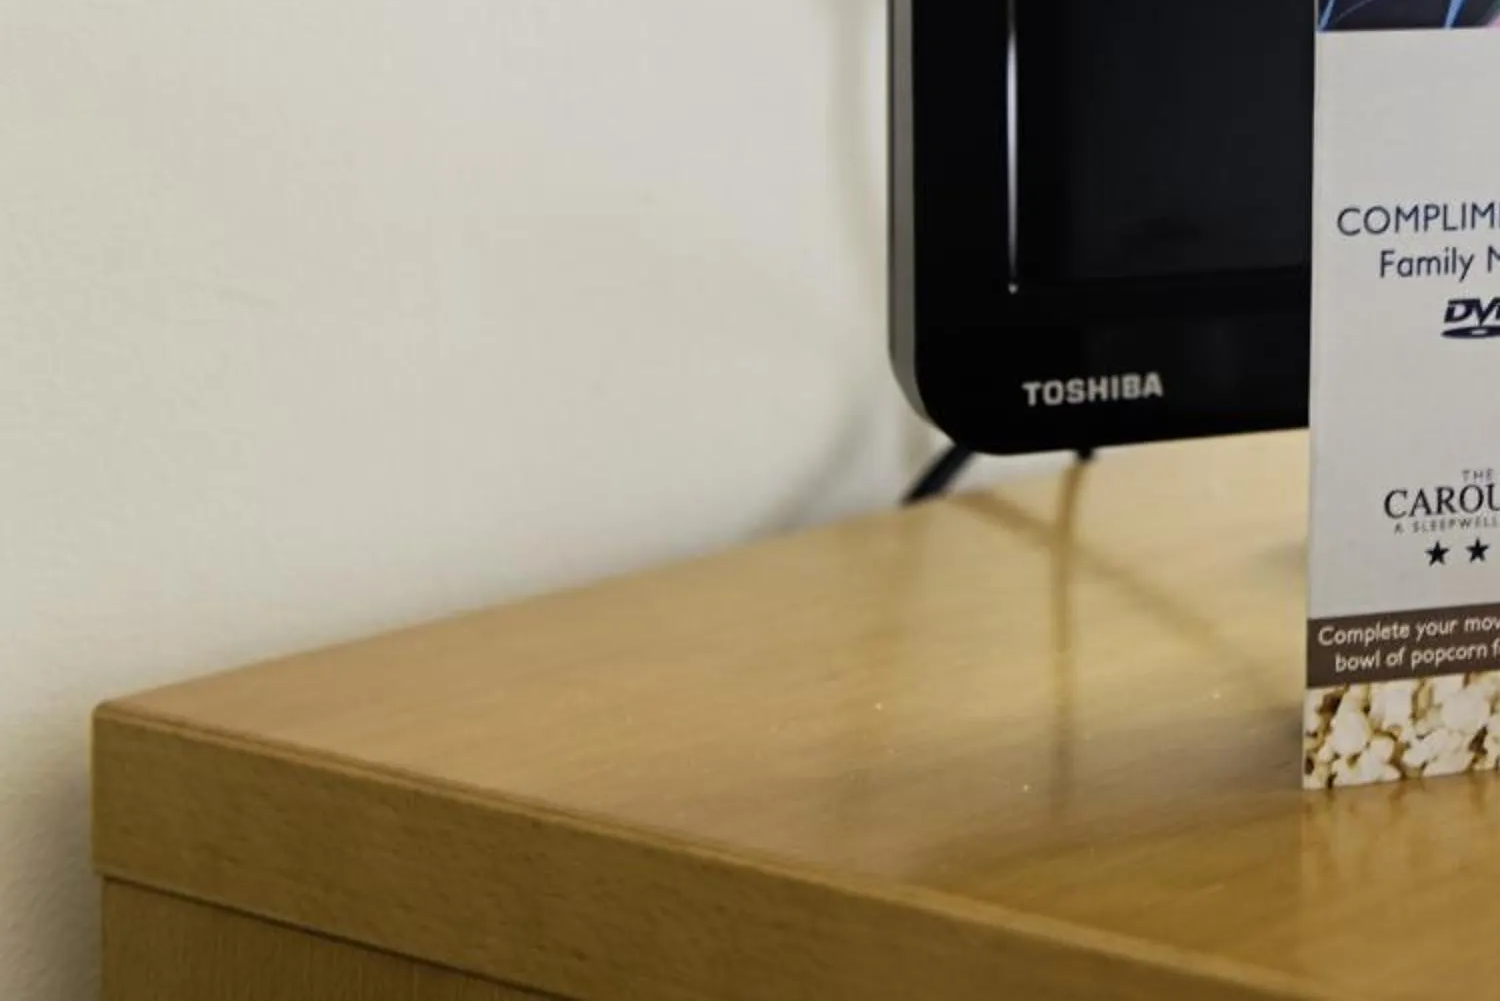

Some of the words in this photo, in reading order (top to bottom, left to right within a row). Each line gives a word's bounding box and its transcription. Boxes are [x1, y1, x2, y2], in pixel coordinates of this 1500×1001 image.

[1379, 246, 1475, 282] Family
[1021, 370, 1165, 407] TOSHIBA
[1461, 467, 1494, 483] THE
[1393, 521, 1405, 535] A
[1317, 620, 1411, 647] Complete
[1415, 617, 1460, 643] your
[1334, 649, 1381, 674] bowl
[1385, 644, 1407, 668] of
[1410, 643, 1488, 671] popcorn
